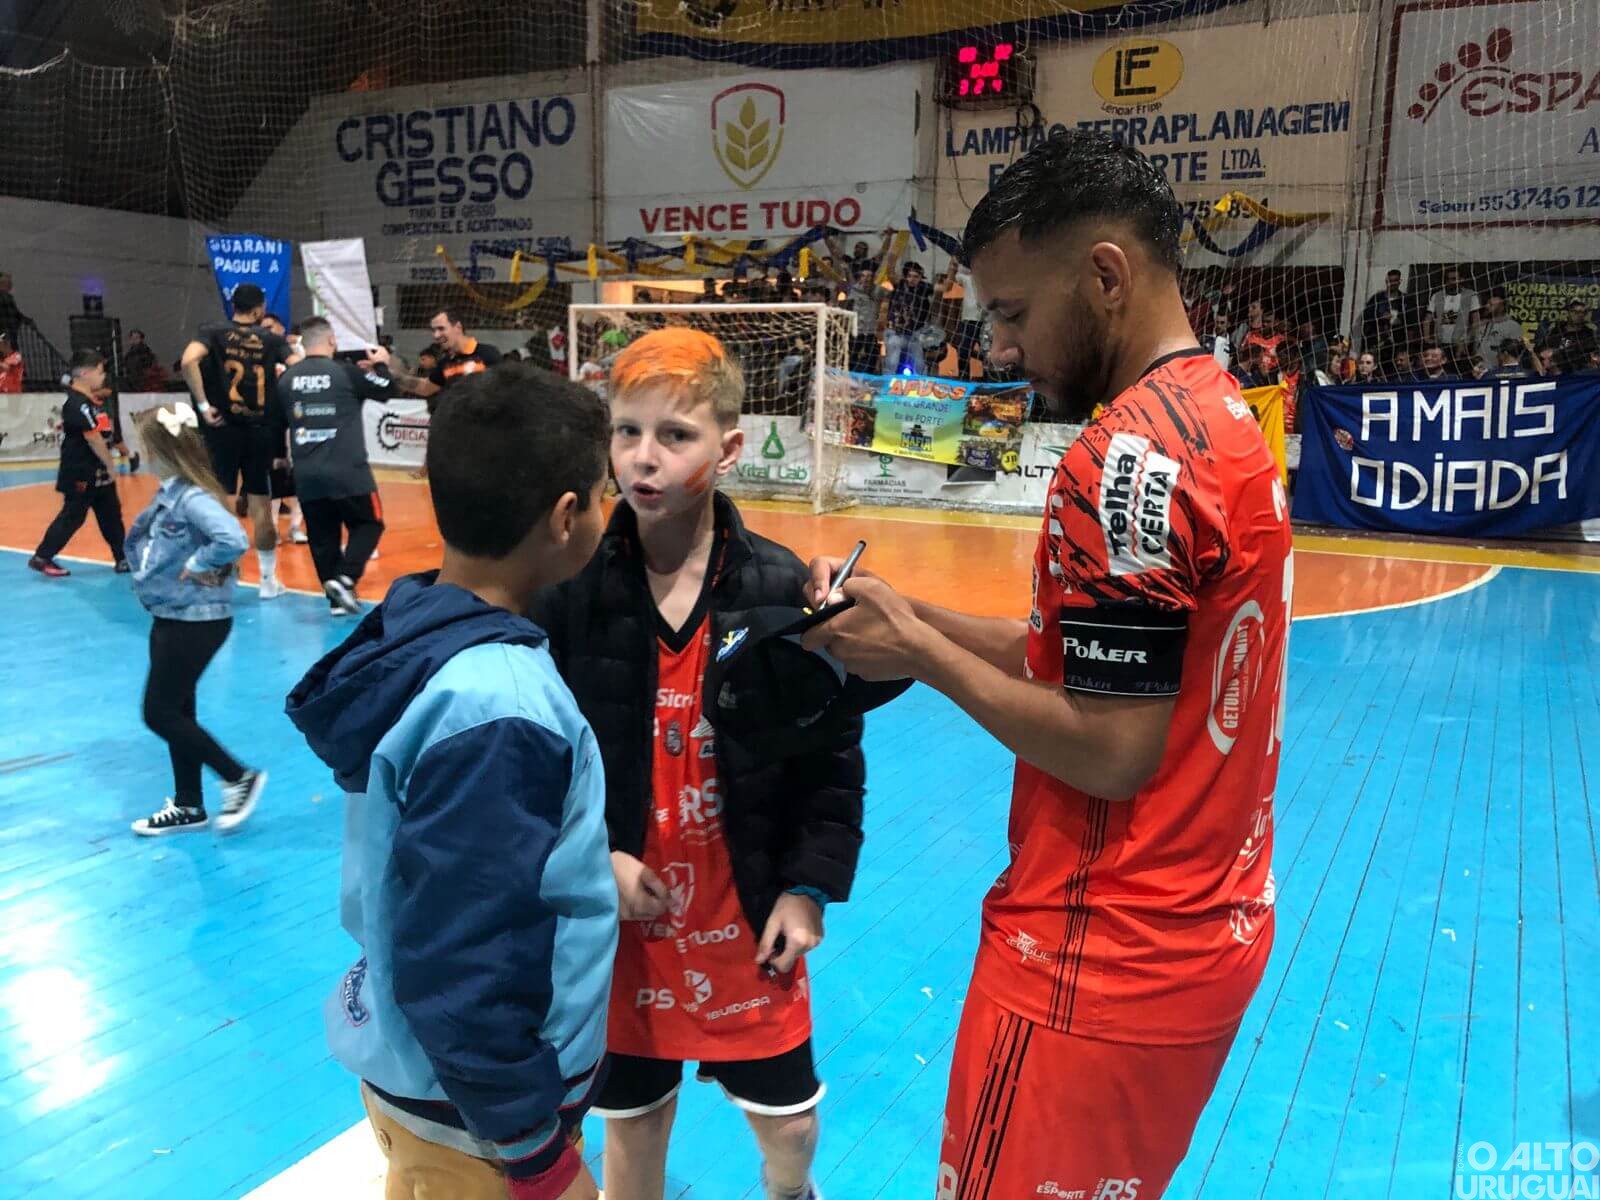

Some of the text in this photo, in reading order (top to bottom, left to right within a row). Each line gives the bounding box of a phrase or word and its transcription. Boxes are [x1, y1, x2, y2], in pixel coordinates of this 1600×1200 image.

[336, 97, 576, 162] CRISTIANO
[376, 152, 533, 207] GESSO
[639, 198, 862, 234] VENCE TUDO
[214, 257, 280, 274] PAGUE A
[223, 359, 266, 407] 21
[291, 374, 332, 391] AFUCS
[1361, 392, 1398, 442] A
[778, 465, 807, 481] Lab
[1104, 452, 1138, 556] Telha
[1139, 470, 1171, 556] CERTA
[656, 688, 697, 708] Sicr
[684, 777, 725, 824] RS
[688, 923, 740, 945] TUDO
[636, 988, 676, 1010] PS
